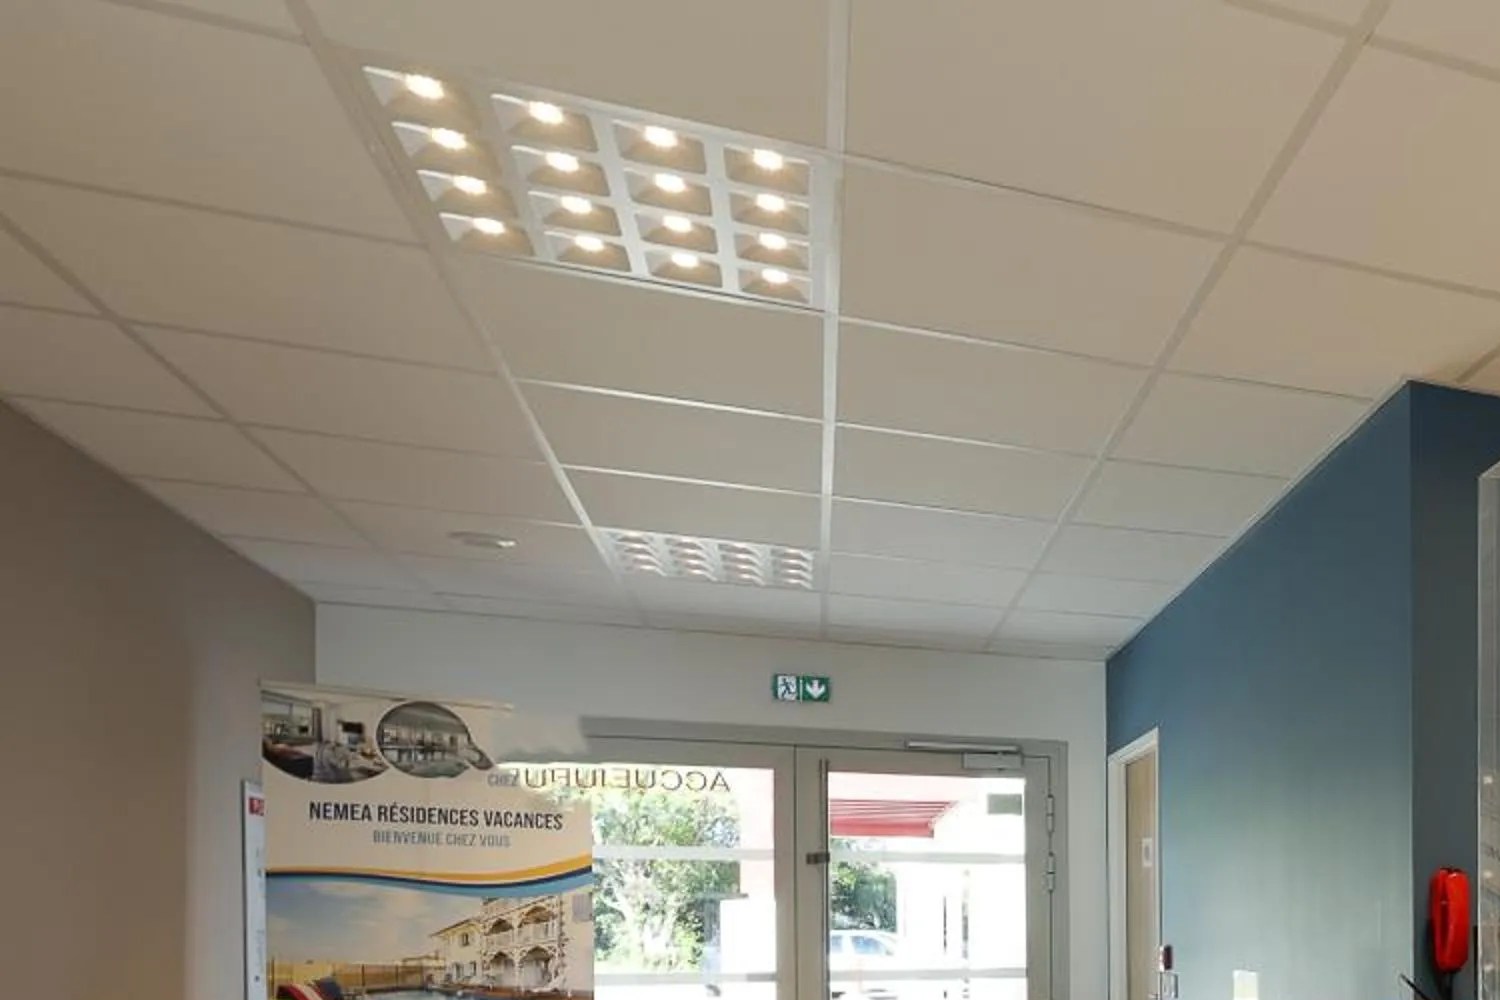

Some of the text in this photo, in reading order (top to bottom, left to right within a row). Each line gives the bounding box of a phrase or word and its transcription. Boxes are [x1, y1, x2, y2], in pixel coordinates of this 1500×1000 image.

[308, 801, 564, 831] NEMEA RÉSIDENCES VACANCES
[372, 830, 512, 848] BIENVENUE CHEZ VOUS
